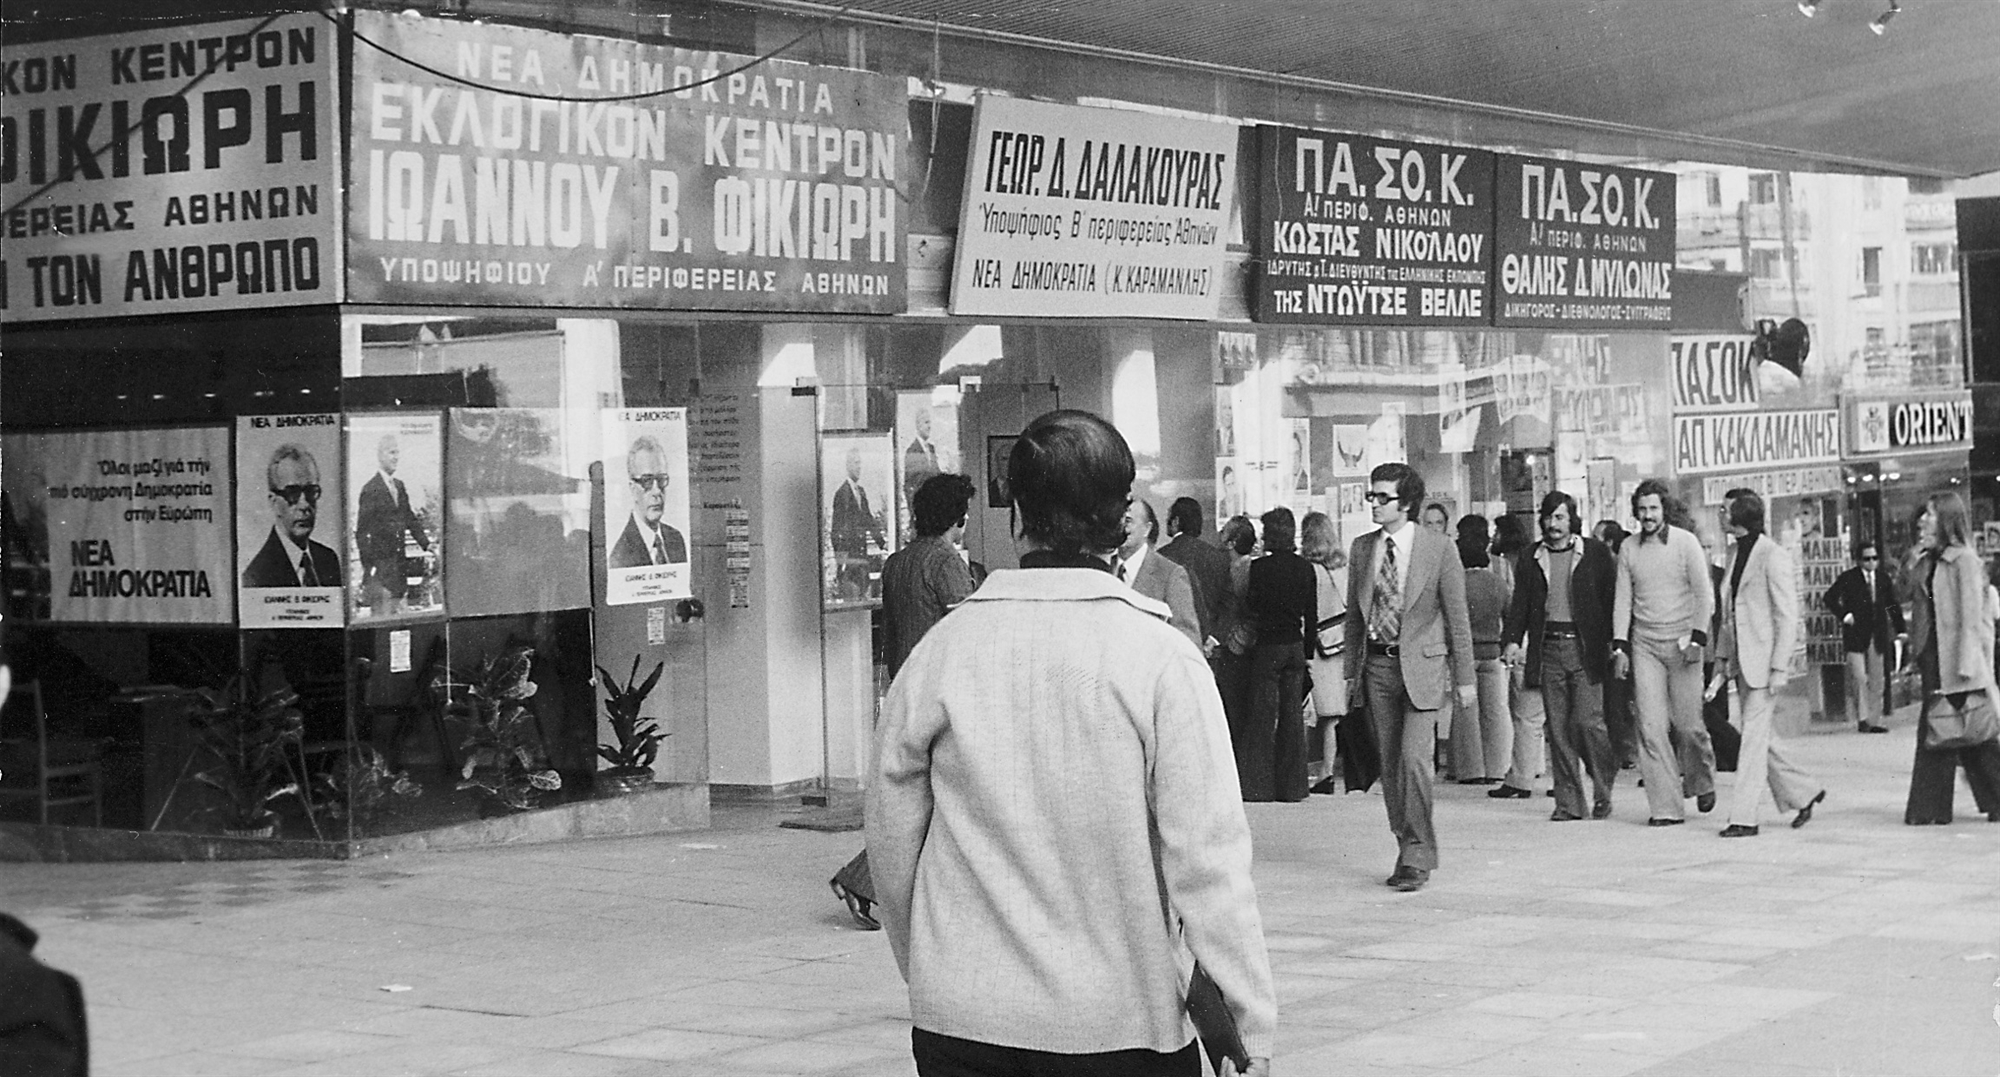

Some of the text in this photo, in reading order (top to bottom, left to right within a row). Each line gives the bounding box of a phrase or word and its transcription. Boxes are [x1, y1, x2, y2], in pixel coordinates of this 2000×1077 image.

[111, 27, 315, 85] ΚΕΝΤΡΟΝ
[457, 41, 834, 115] ΝΕΑ ΔΗΜΟΚΡΑΤΙΑ
[371, 82, 896, 181] ΕΚΛΟΓΙΚΟΝ ΚΕΝΤΡΟΝ
[985, 130, 1226, 211] ΓΕΩΡ. Δ. ΔΑΛΑΚΟΥΡΑΣ
[0, 184, 318, 238] ΕΡΕΙΑΣ ΑΘΗΝΩΝ
[368, 149, 896, 263] ΙΩΑΝΝΟΥ Β. ΦΙΚΙΩΡΗ
[1324, 200, 1374, 221] ΠΕΡΙΦ.
[1384, 205, 1451, 227] ΑΘΗΝΩΝ
[1088, 214, 1172, 248] περιφερείας
[1273, 221, 1484, 264] ΚΩΣΤΑΣ ΝΙΚΟΛΑΟΥ
[1548, 229, 1586, 249] ΠΕΡΙΦ.
[1593, 233, 1647, 252] ΑΘΗΝΩΝ
[27, 253, 102, 307] ΤΟΝ
[124, 237, 320, 302] ΑΝΘΡΩΠΟ
[380, 257, 552, 285] ΥΠΟΨΗΦΙΟΥ
[614, 265, 777, 292] ΠΕΡΙΦΕΡΕΙΑΣ
[801, 271, 890, 296] ΑΘΗΝΩΝ
[972, 258, 1001, 289] ΝΕΑ
[1011, 260, 1096, 292] ΔΗΜΟΚΡΑΤΙΑ
[1267, 259, 1312, 277] ΙΔΡΥΤΗΣ
[1502, 253, 1568, 296] ΘΑΛΗΣ
[1274, 290, 1303, 314] ΤΗΣ
[1421, 287, 1482, 317] ΒΕΛΛΕ
[250, 415, 335, 428] ΝΕΑ ΔΗΜΟΚΡΑΤΙΑ
[635, 411, 681, 421] ΔΗΜΟΚΡΑΤΙΑ
[1894, 400, 1974, 446] ORIENT
[1712, 412, 1837, 466] ΚΑΚΛΑΜΑΝΗΣ
[134, 458, 162, 477] μαζί
[134, 481, 213, 500] Δημοκρατία
[70, 539, 115, 567] ΝΕΑ
[68, 569, 212, 599] ΔΗΜΟΚΡΑΤΙΑ
